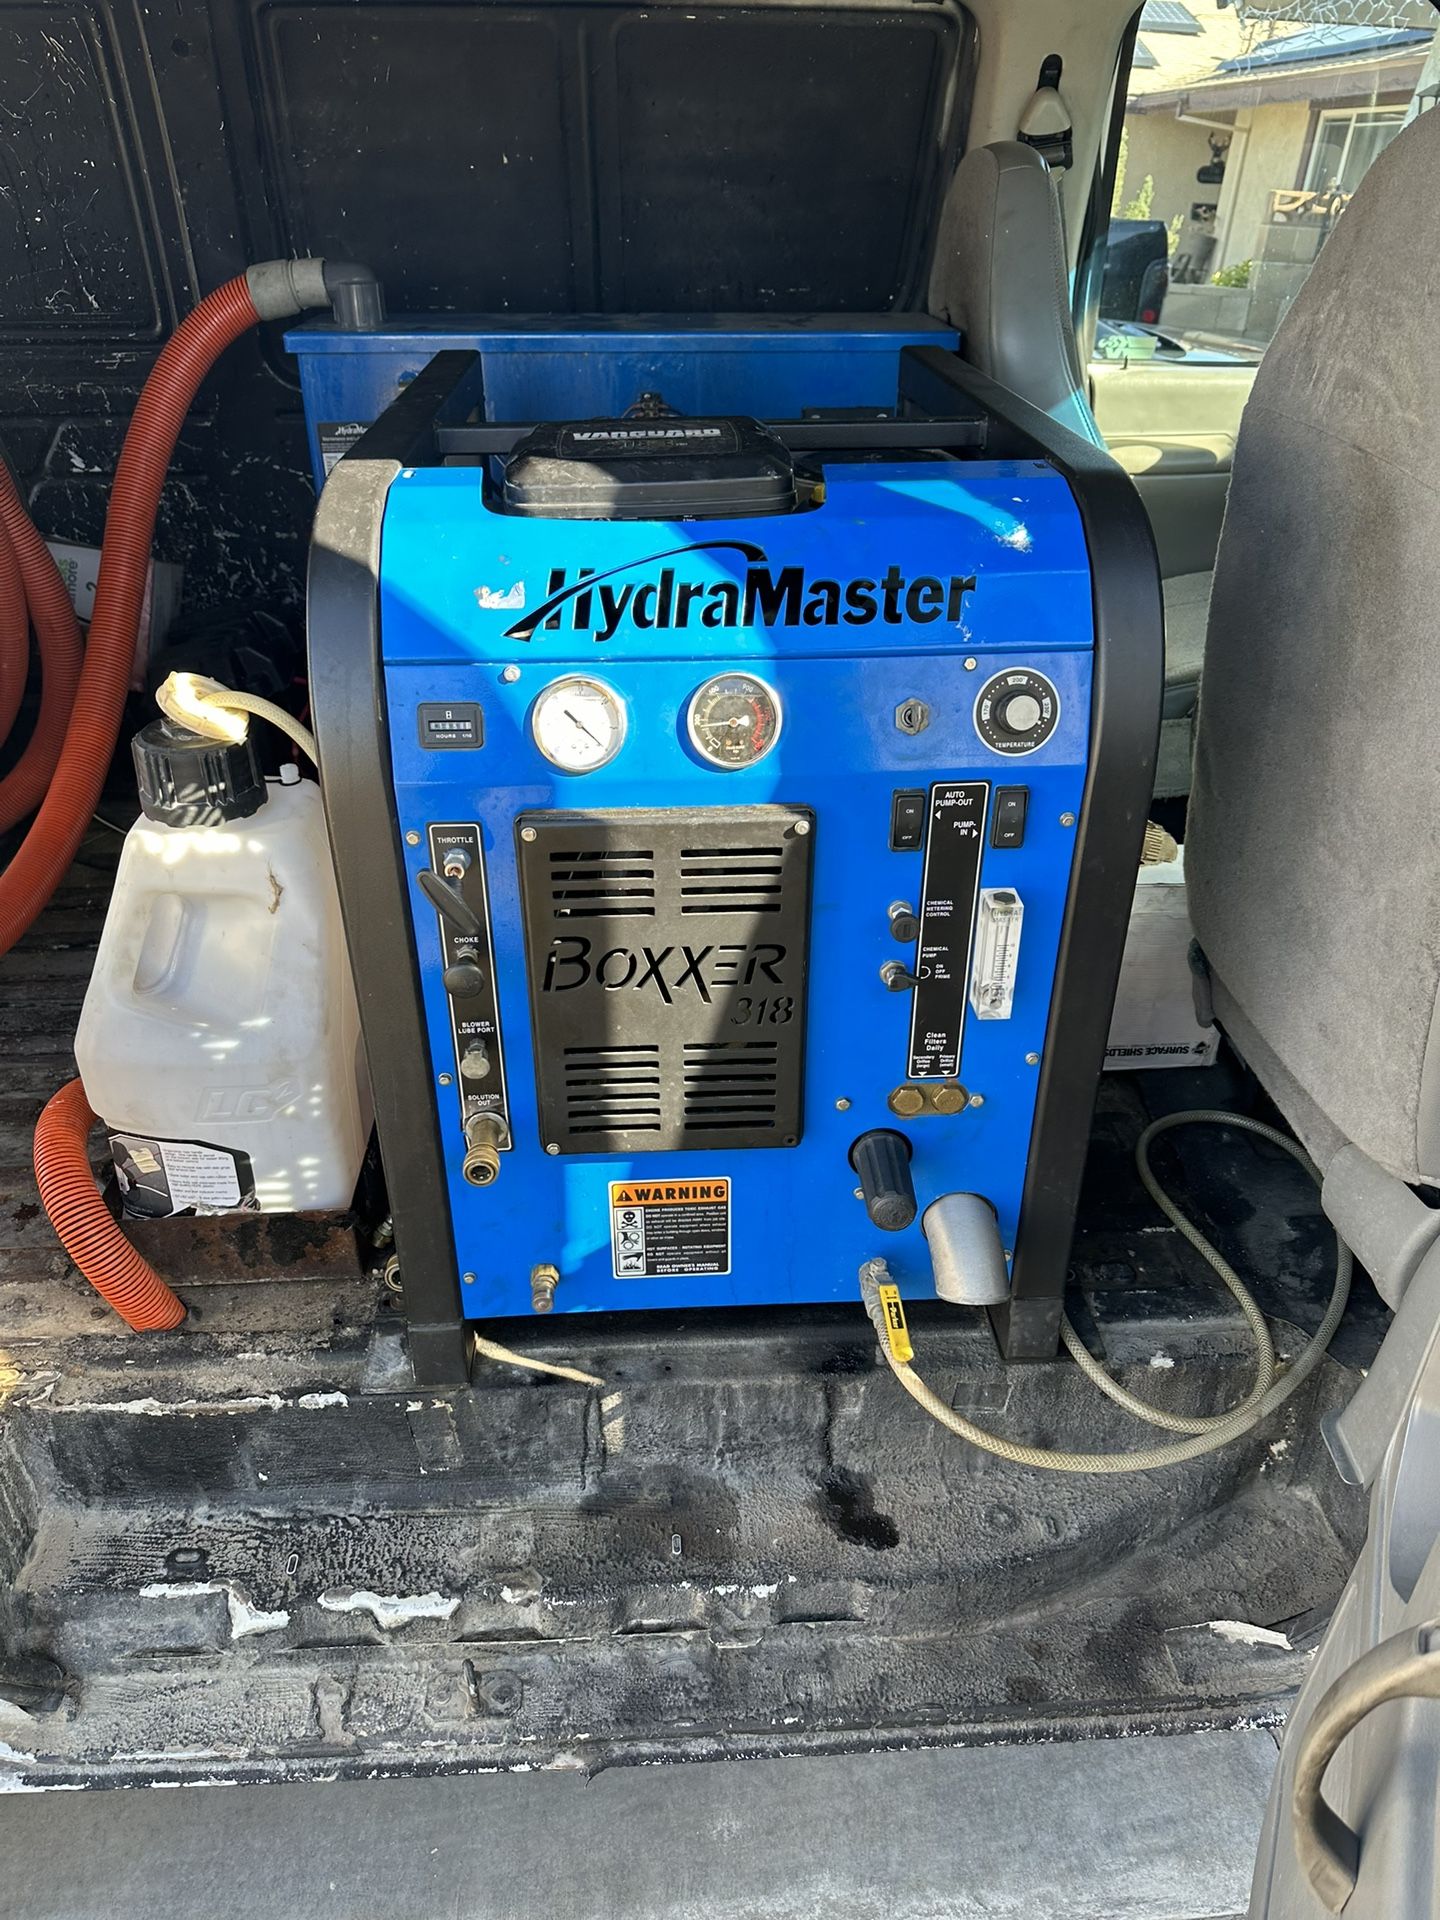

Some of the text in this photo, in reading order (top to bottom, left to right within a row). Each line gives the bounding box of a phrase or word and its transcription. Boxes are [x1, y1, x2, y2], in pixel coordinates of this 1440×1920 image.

[573, 428, 721, 441] VANGUARD
[505, 560, 978, 643] HydraMaster
[945, 791, 965, 799] AUTO
[935, 798, 973, 807] PUMP-OUT
[953, 821, 976, 829] PUMP-
[960, 828, 968, 836] IN
[437, 836, 474, 844] THROTTLE
[541, 936, 787, 1006] BOXXER
[731, 997, 796, 1026] 318
[1145, 1046, 1190, 1055] SURFACE
[634, 1185, 725, 1200] WARNING
